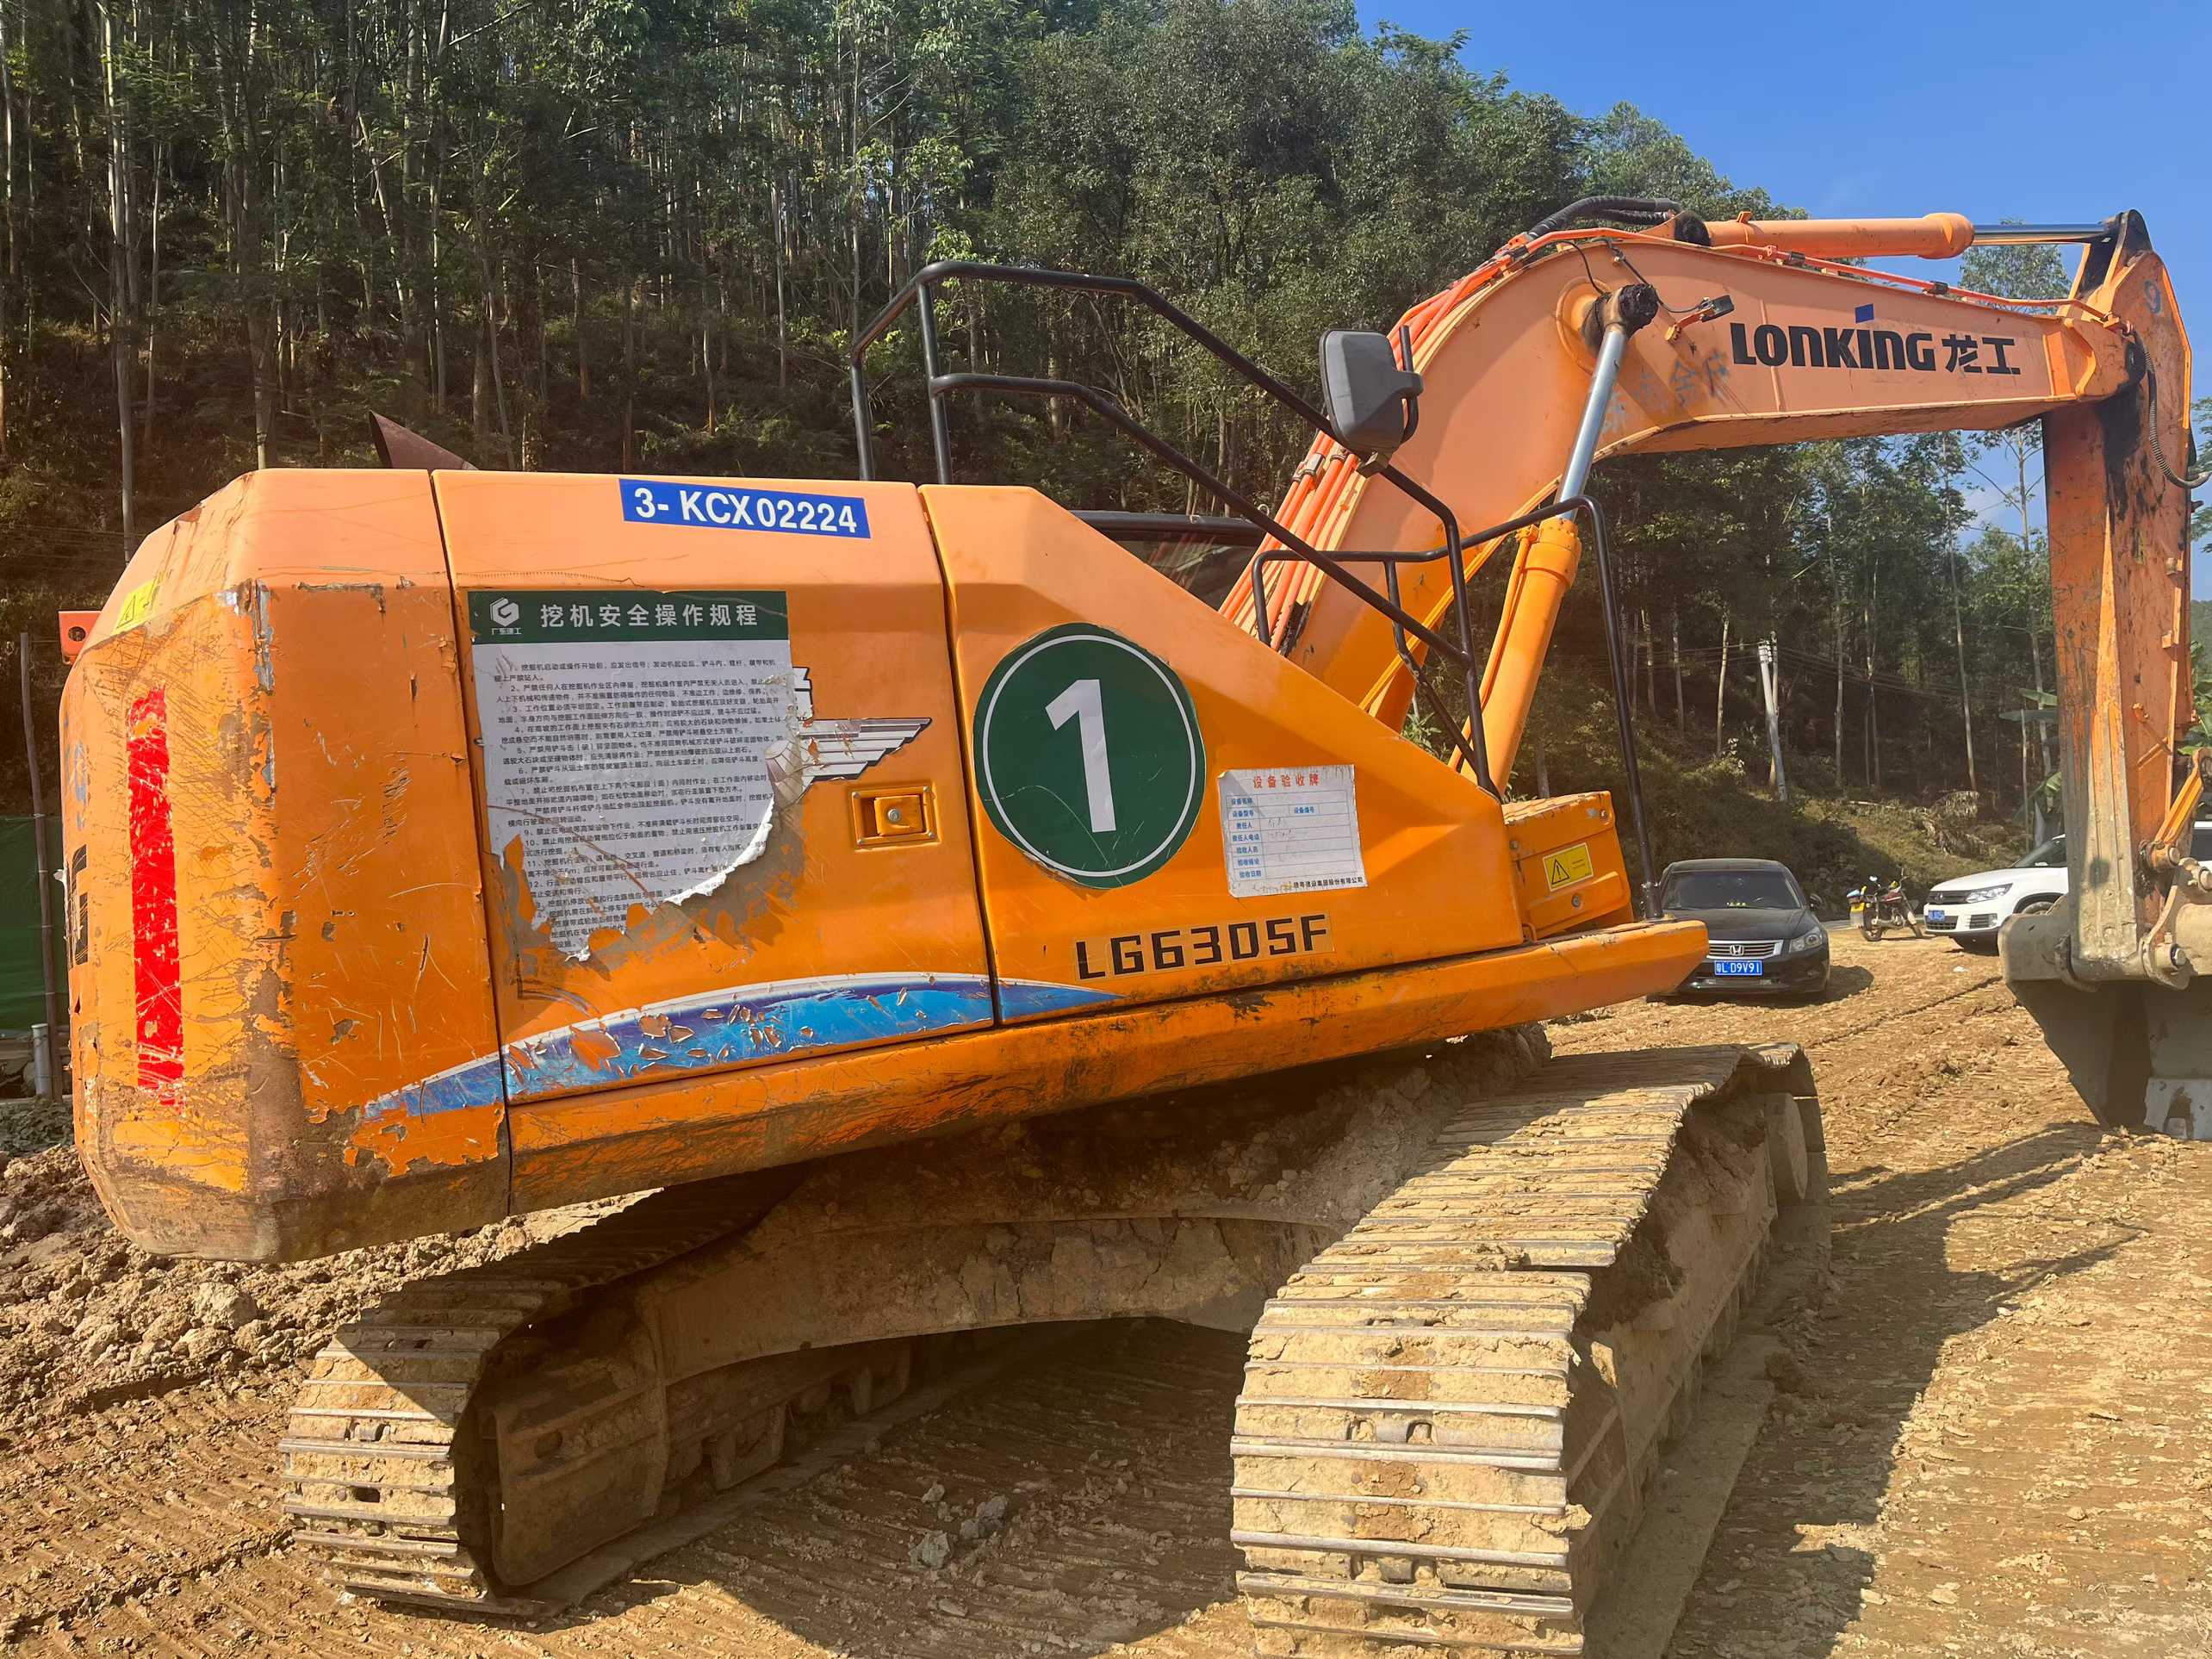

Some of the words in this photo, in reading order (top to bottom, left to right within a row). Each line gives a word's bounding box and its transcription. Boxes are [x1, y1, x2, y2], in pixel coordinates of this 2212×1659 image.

[1730, 321, 1936, 372] LONKING
[1942, 333, 2022, 376] 龙工
[680, 488, 858, 533] KCX02224
[540, 603, 759, 629] 挖机安全操作规程
[1044, 679, 1116, 833] 1
[1252, 772, 1320, 790] 设备验收牌
[1076, 913, 1327, 980] LG6305F
